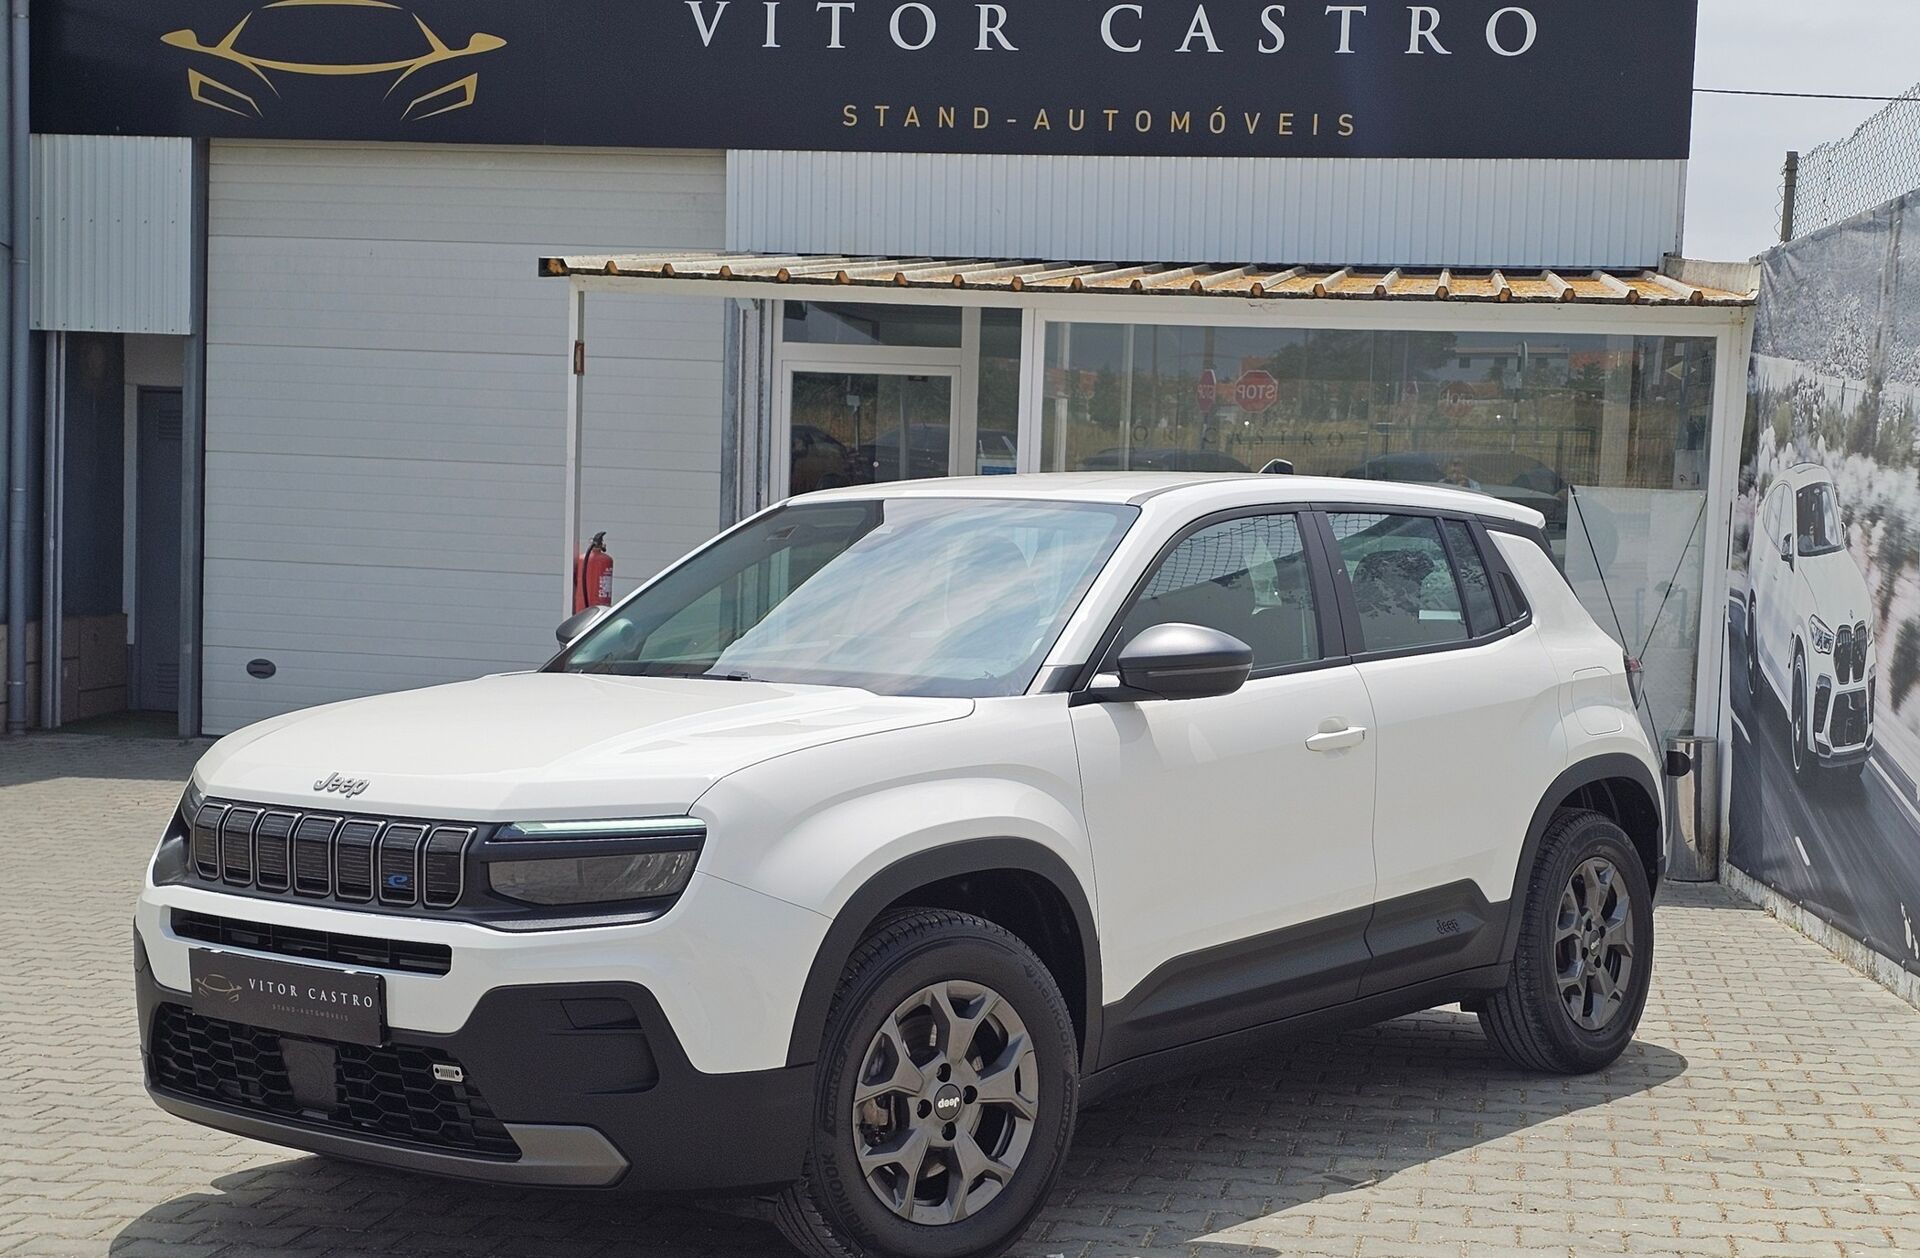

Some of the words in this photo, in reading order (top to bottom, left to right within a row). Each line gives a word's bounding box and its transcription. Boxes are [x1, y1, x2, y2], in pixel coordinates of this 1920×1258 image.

[684, 1, 1019, 51] VITOR
[1100, 3, 1538, 57] CASTRO
[842, 104, 1355, 136] STAND-AUTOMÓVEIS
[313, 771, 370, 798] Jeep
[248, 977, 298, 998] VITOR
[308, 987, 373, 1008] CASTRO
[937, 1096, 960, 1109] Jeep
